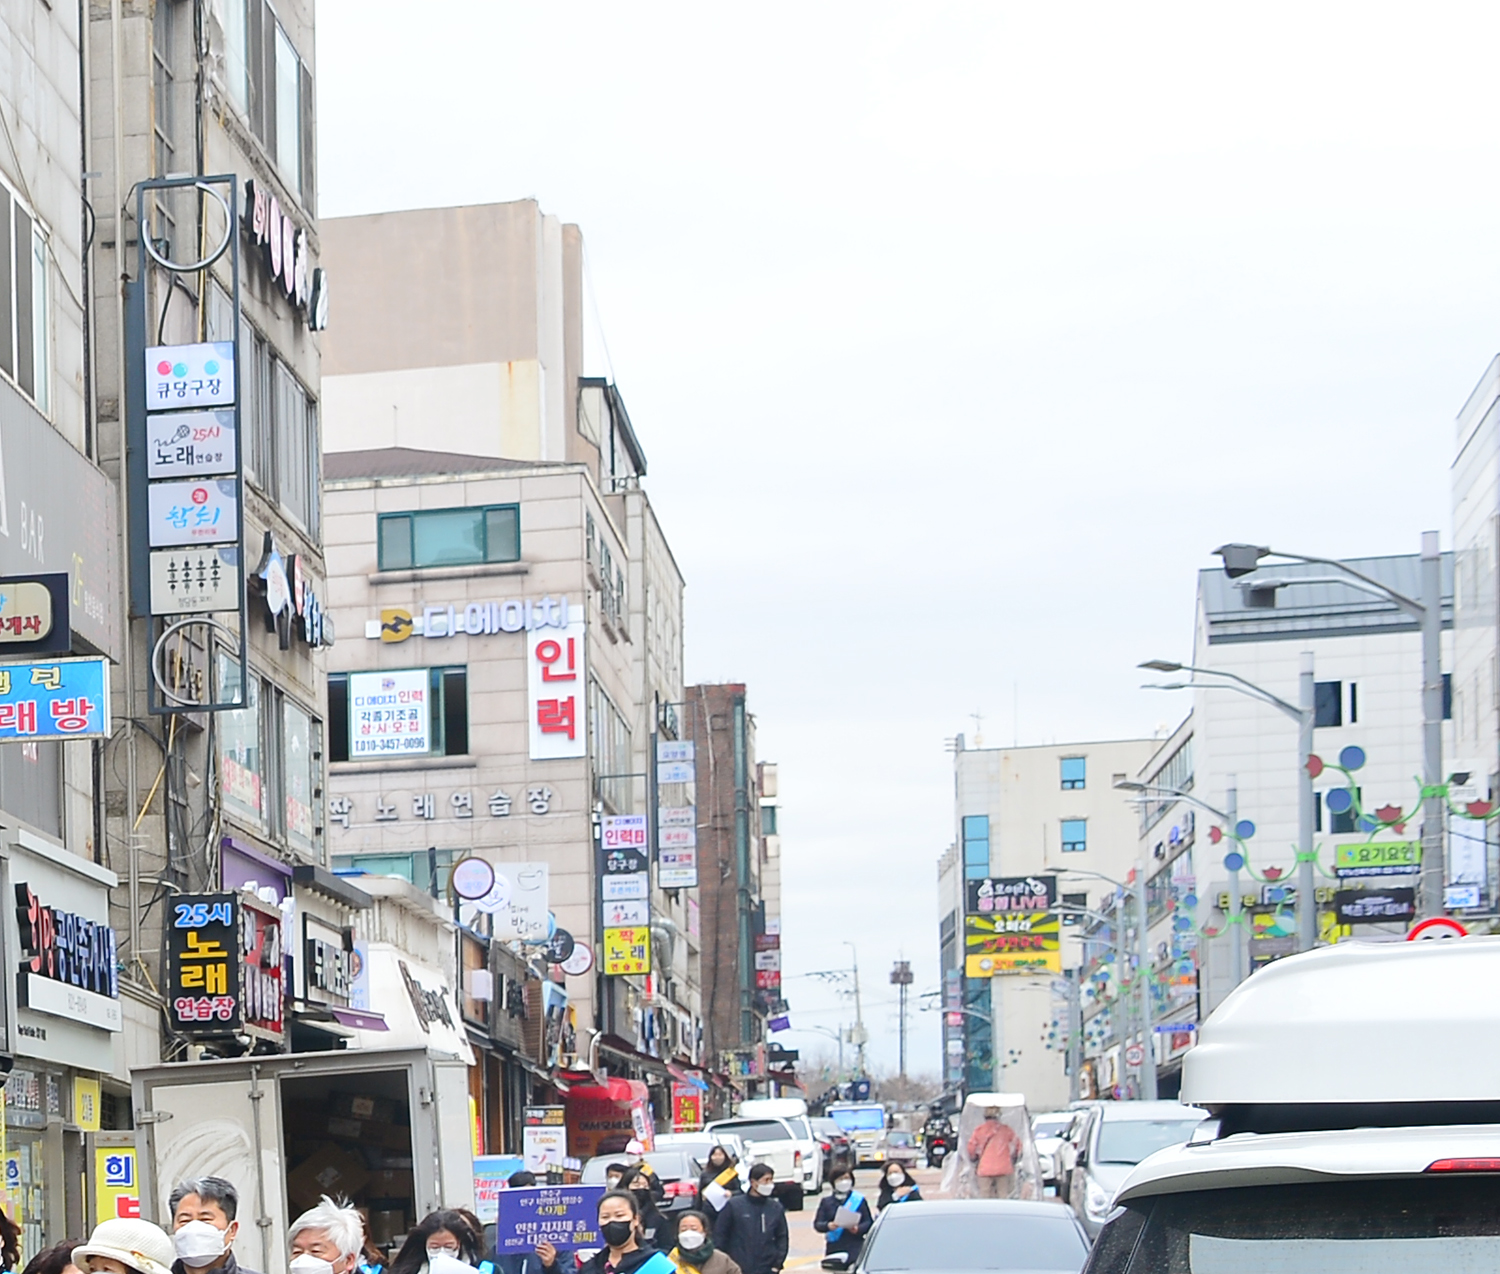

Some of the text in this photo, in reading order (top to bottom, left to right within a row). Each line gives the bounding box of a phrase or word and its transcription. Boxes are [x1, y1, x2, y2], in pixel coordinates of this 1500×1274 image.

[157, 379, 221, 399] 큐당구장
[155, 446, 223, 465] 노래 연습장
[21, 515, 45, 564] BAR
[534, 637, 577, 740] 인력
[175, 903, 231, 927] 25시
[179, 931, 228, 995] 노래
[610, 945, 644, 960] 노래
[175, 997, 235, 1021] 연습장
